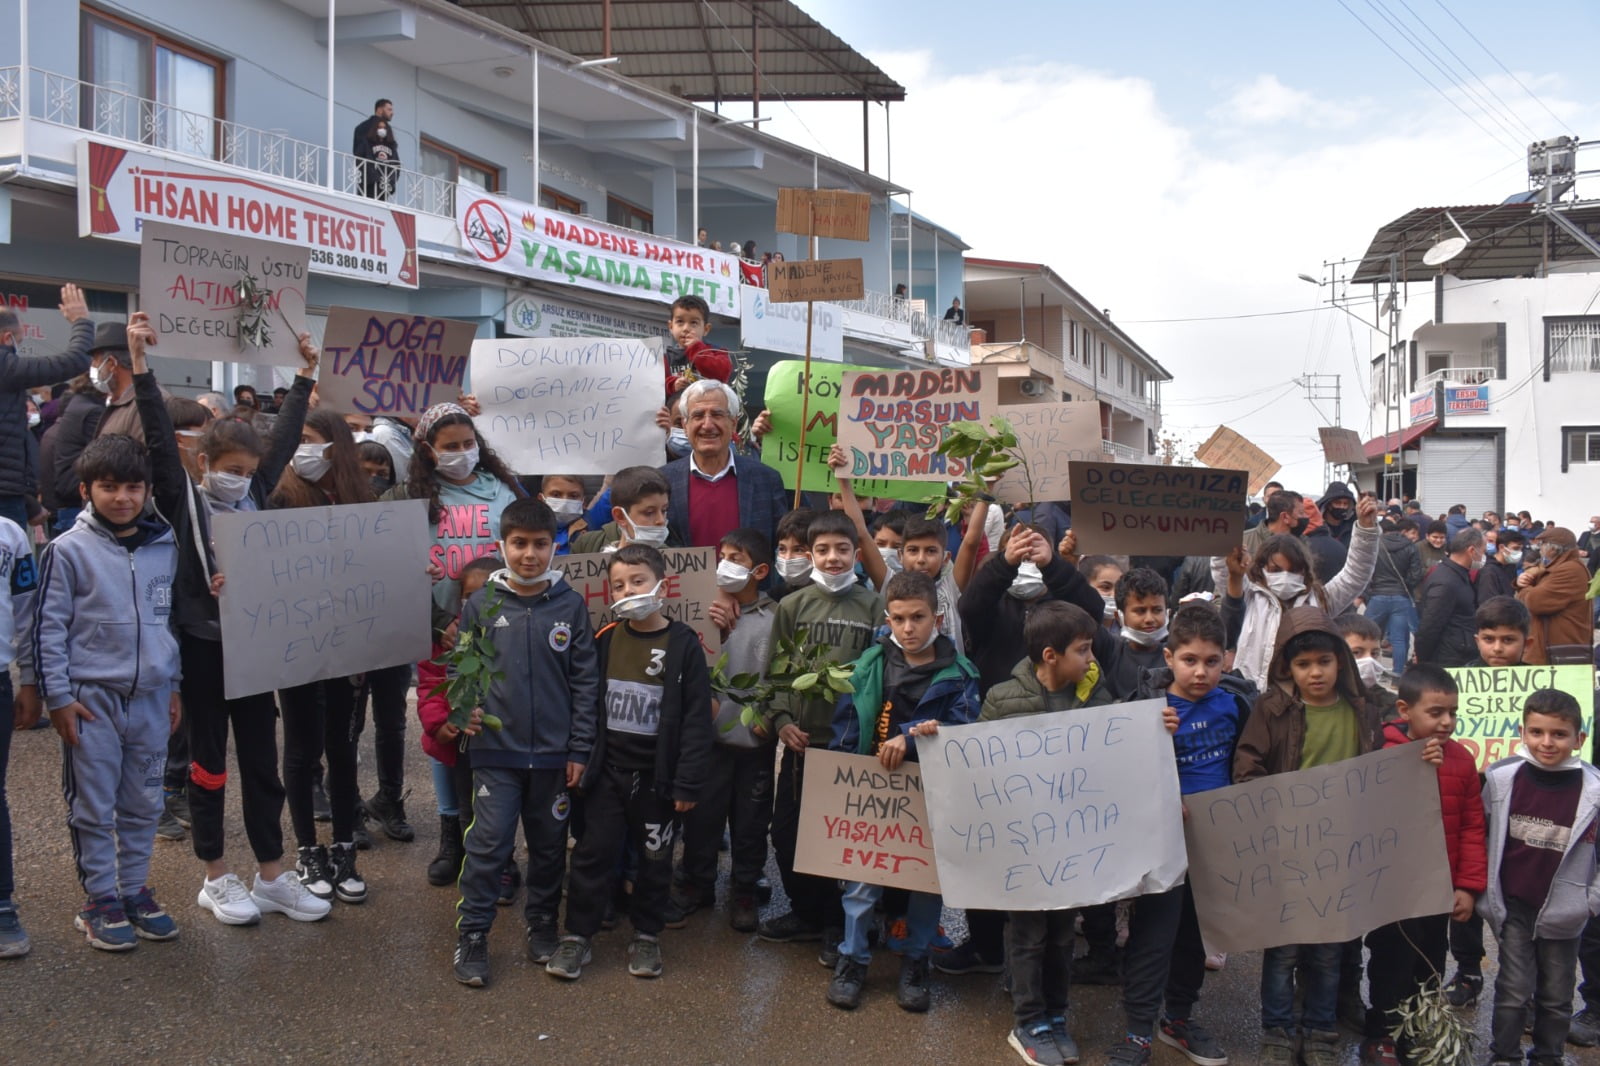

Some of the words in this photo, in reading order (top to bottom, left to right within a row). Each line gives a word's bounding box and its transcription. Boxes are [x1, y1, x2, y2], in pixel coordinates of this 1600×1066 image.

[134, 166, 219, 226] İHSAN
[228, 196, 297, 240] HOME
[303, 211, 387, 257] TEKSTİL
[152, 237, 249, 271] TOPRAĞIN
[311, 249, 334, 265] 536
[336, 253, 358, 270] 380
[360, 258, 374, 273] 49
[376, 261, 388, 275] 41
[544, 217, 639, 257] MADENE
[644, 242, 706, 272] HAYIR
[709, 258, 715, 275] !
[261, 256, 303, 280] ÜSTÜ
[520, 239, 652, 290] YAŞAMA
[660, 271, 720, 305] EVET
[727, 286, 734, 308] !
[775, 262, 833, 281] MADENE
[166, 274, 304, 311] ALTINN
[360, 315, 446, 351] DOĞA
[541, 304, 565, 317] ARSUZ
[593, 313, 613, 326] TARIM
[628, 321, 637, 331] VE
[325, 346, 468, 387] TALANINA
[496, 342, 662, 371] DOKUNMAYIN
[352, 380, 433, 414] SON!
[488, 375, 633, 405] DOĞAMIZA
[851, 369, 982, 400] MADEN
[492, 396, 627, 433] MADENE
[847, 397, 980, 424] DURSUN
[538, 427, 641, 460] HAYIR
[243, 509, 395, 547] MADENE
[436, 504, 491, 538] AWE
[1102, 511, 1229, 535] DOKUNMA
[271, 549, 367, 586] HAYIR
[242, 580, 386, 638] YAŞAMA
[284, 615, 382, 663] EVET
[944, 717, 1133, 769] MADENE
[1191, 721, 1208, 731] THE
[834, 765, 924, 793] MADEN
[973, 767, 1105, 810] HAYIR
[1209, 757, 1400, 826] MADENE
[844, 791, 919, 823] HAYIR
[824, 815, 935, 850] YAŞAMA
[950, 803, 1121, 856] YAŞAMA
[1233, 816, 1345, 859] HAYIR
[842, 847, 929, 874] EVET
[1005, 842, 1116, 892] EVET
[1220, 827, 1398, 902] YAŞAMA
[1279, 864, 1391, 924] EVET
